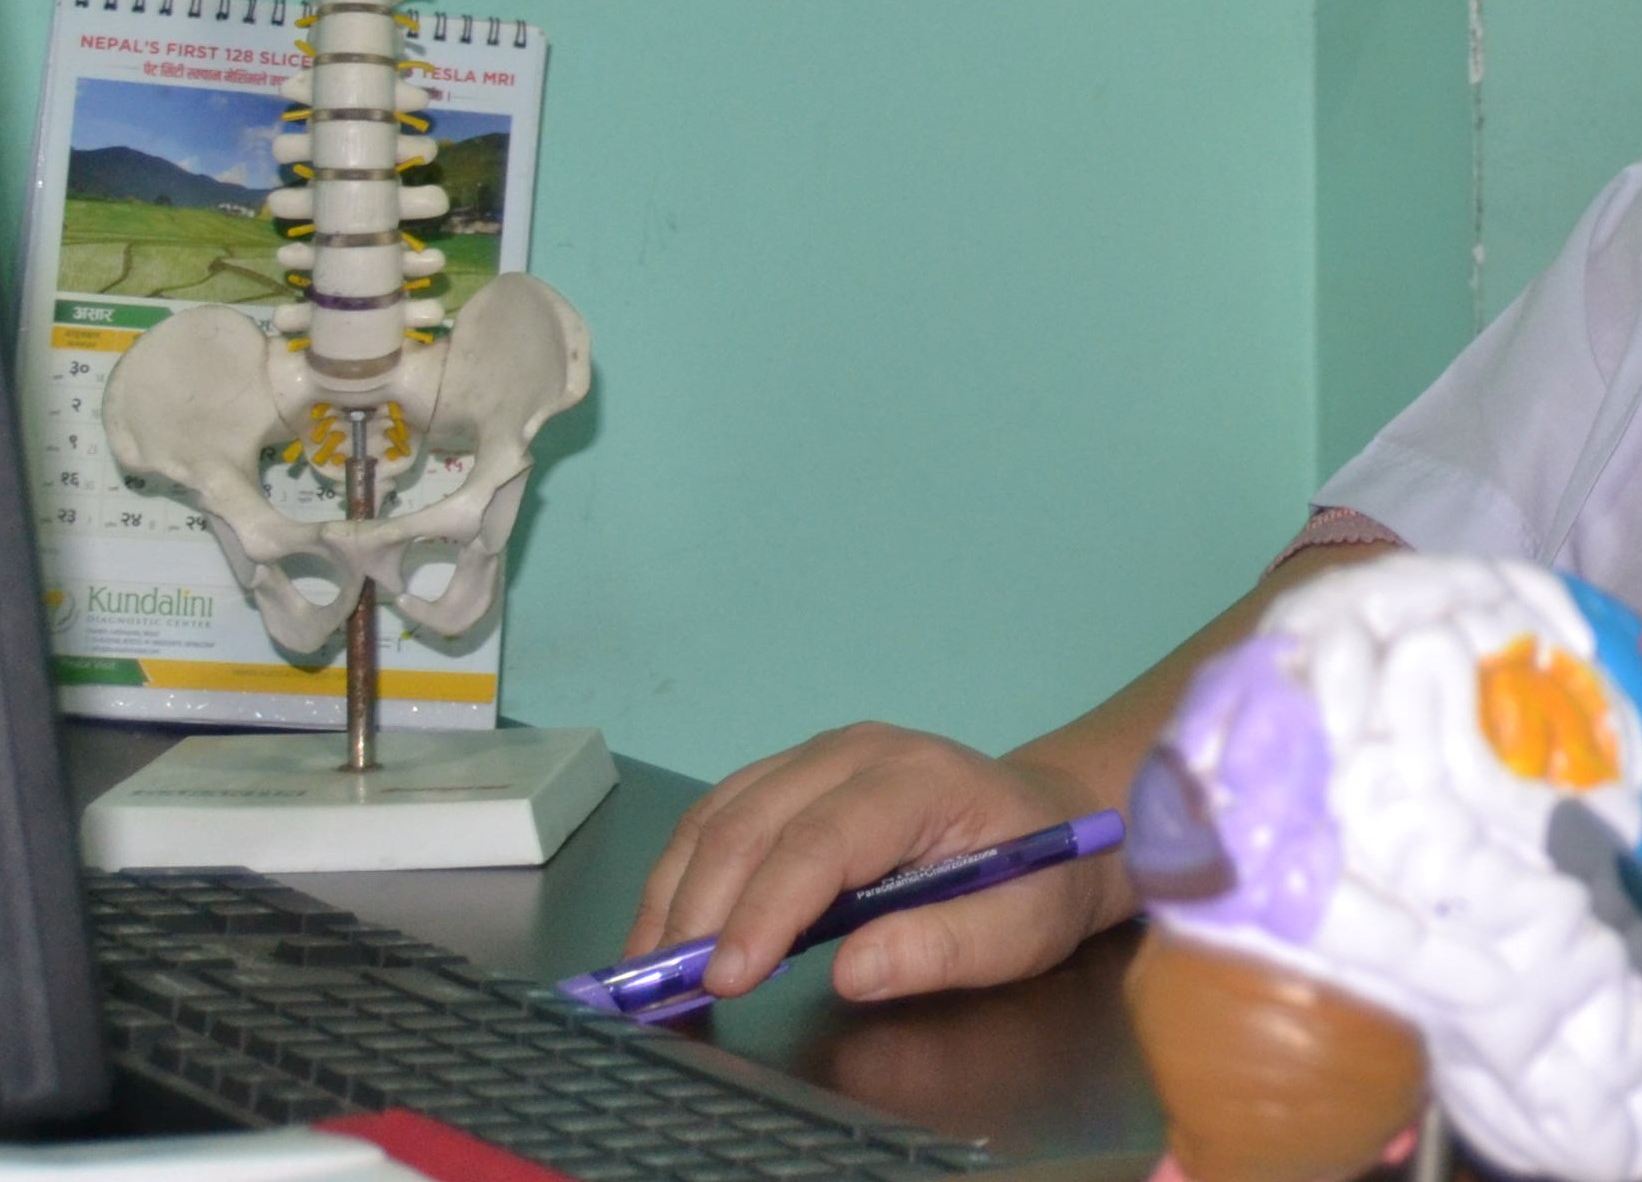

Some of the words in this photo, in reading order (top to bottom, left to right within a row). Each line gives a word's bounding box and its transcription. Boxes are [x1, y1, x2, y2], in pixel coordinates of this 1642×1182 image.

[81, 35, 160, 55] NEPAL'S
[166, 43, 219, 60] FIRST
[225, 48, 253, 63] 128
[260, 51, 312, 68] SLICE
[483, 71, 515, 87] MRI
[73, 306, 115, 322] असार
[69, 361, 90, 376] ३०
[72, 398, 82, 412] २
[61, 472, 80, 488] १६
[316, 487, 336, 501] २०
[58, 509, 76, 524] २३
[120, 512, 142, 527] २४
[186, 516, 208, 531] २५
[88, 586, 213, 618] Kundalini
[86, 615, 161, 627] DIAGNOSTIC
[166, 618, 212, 629] CENTER
